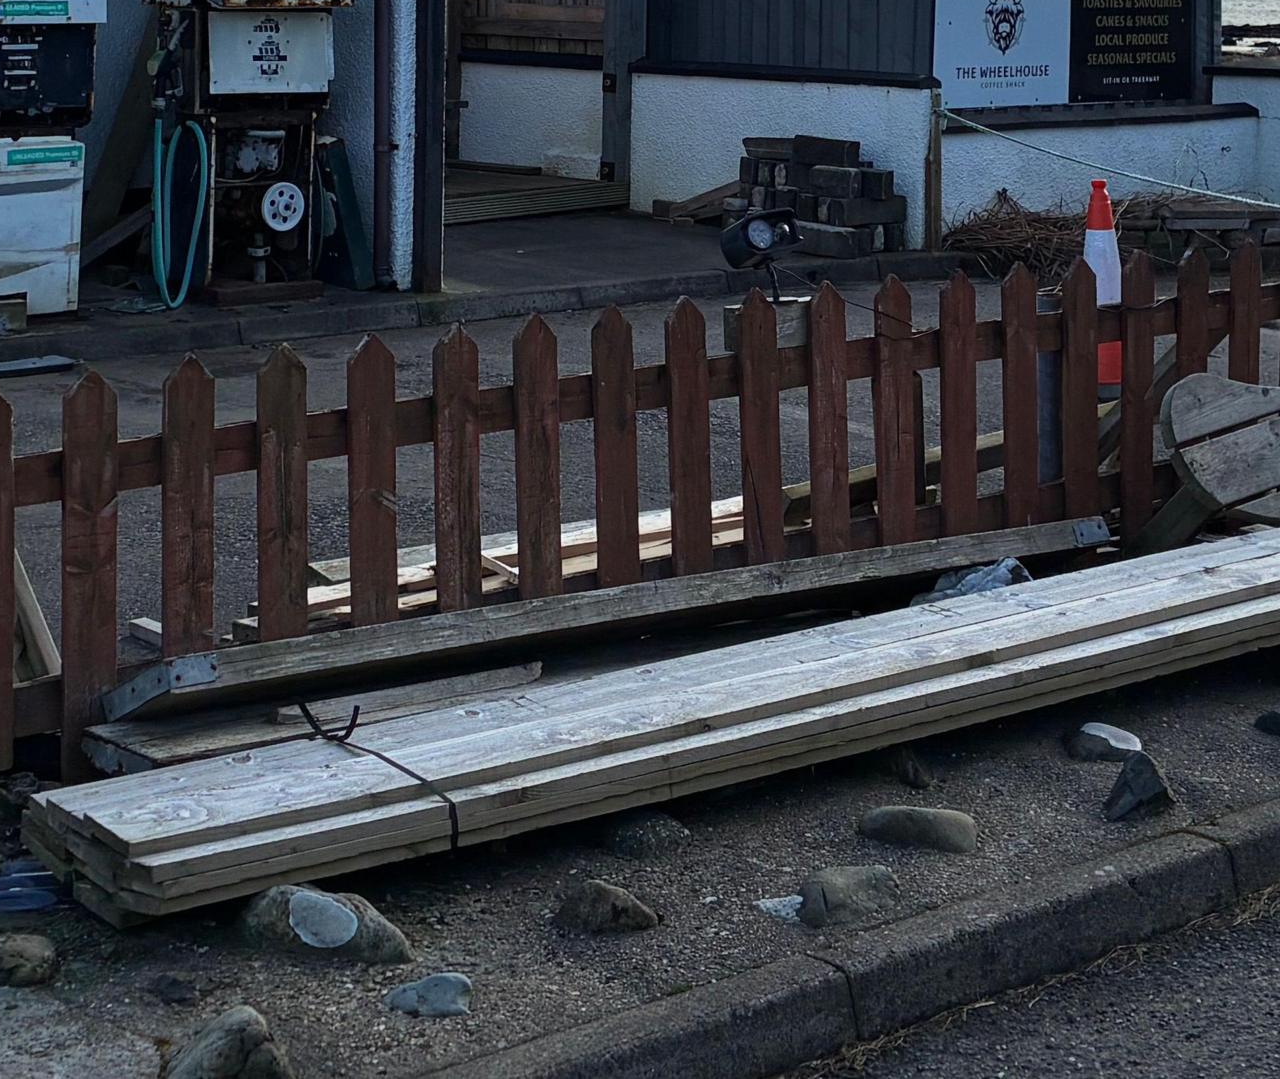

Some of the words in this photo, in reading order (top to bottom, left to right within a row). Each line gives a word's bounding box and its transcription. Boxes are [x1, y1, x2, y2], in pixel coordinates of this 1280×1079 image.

[1095, 15, 1125, 27] CAKES
[1126, 15, 1134, 27] &
[1135, 15, 1169, 27] SNACKS
[1095, 34, 1125, 46] LOCAL
[1126, 33, 1169, 45] PRODUCE
[1087, 53, 1134, 65] SEASONAL
[1136, 51, 1177, 64] SPECIALS
[956, 67, 976, 80] THE
[980, 65, 1050, 78] WHEELHOUSE
[1006, 81, 1025, 89] SHACK
